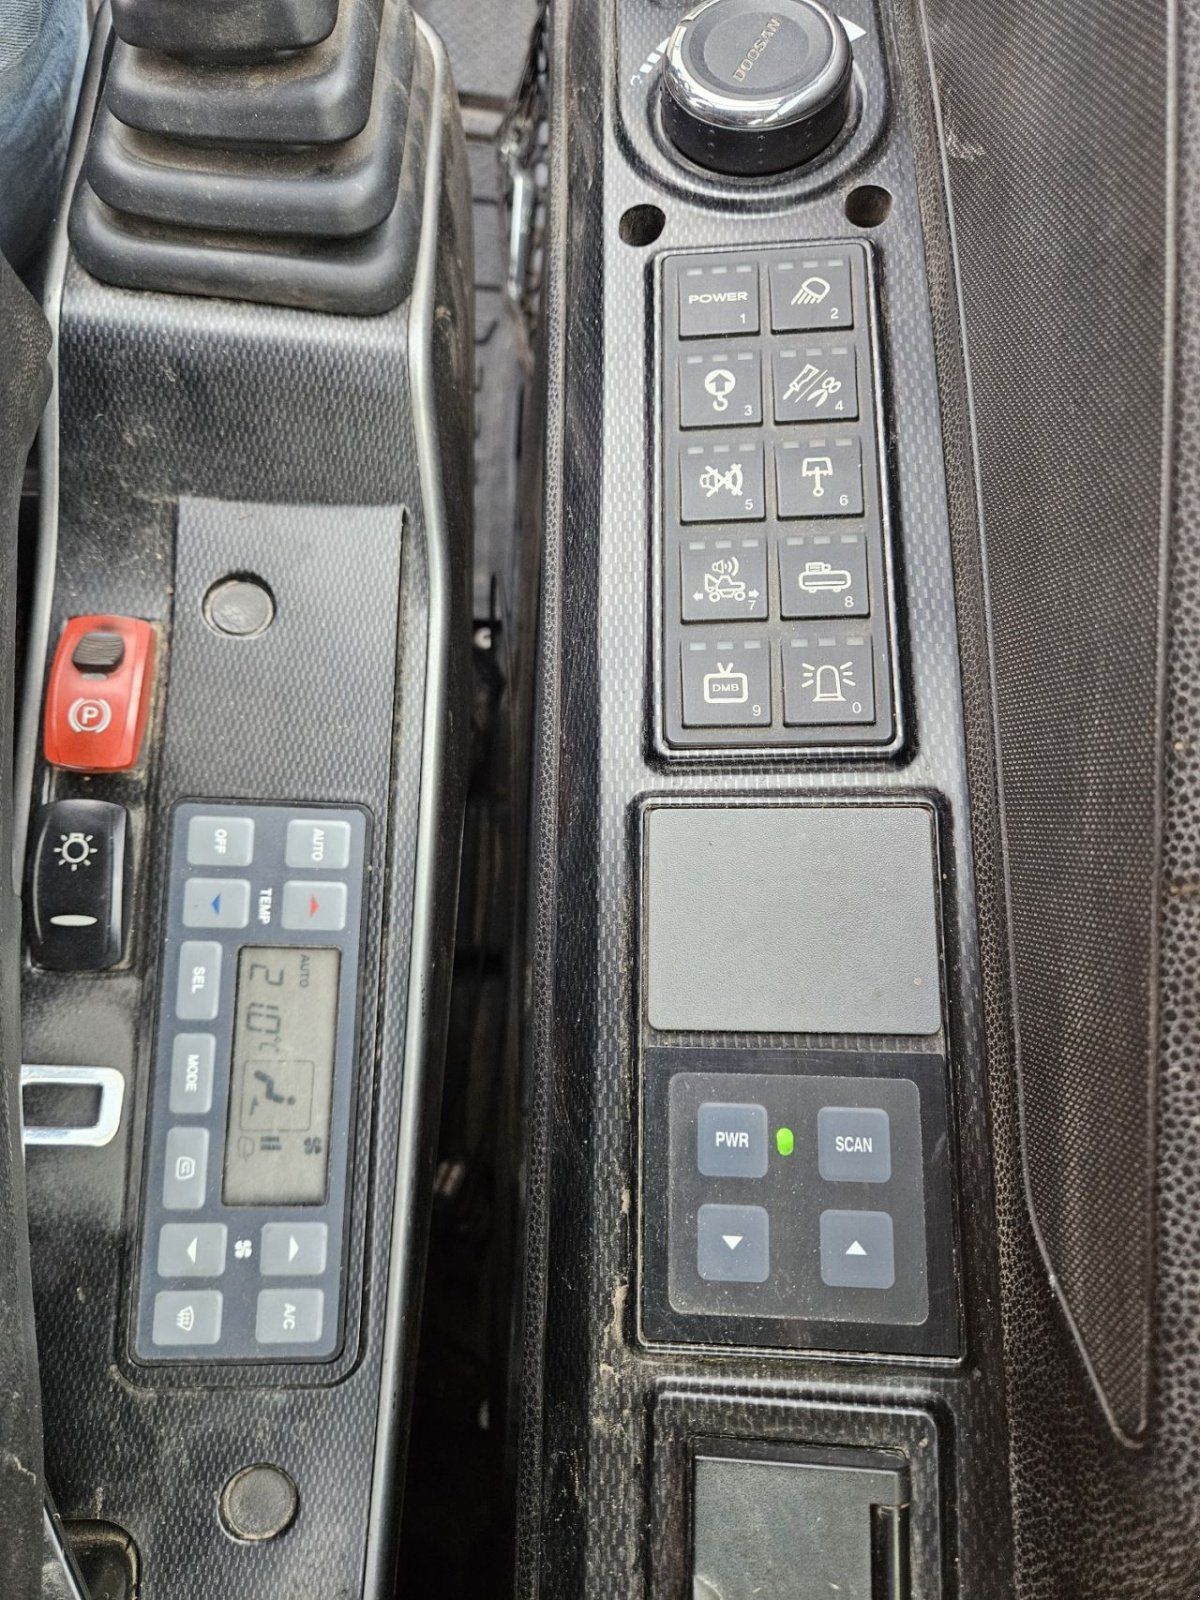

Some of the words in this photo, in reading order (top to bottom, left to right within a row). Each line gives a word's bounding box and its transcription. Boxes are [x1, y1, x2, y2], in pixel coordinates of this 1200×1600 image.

[732, 15, 781, 83] DOOSAN
[688, 291, 748, 304] POWER
[740, 313, 746, 324] 1
[830, 308, 839, 320] 2
[744, 405, 753, 416] 3
[835, 400, 844, 411] 4
[745, 499, 754, 510] 5
[839, 494, 848, 506] 6
[748, 600, 757, 610] 7
[844, 596, 854, 607] 8
[712, 683, 739, 692] DMB
[752, 704, 761, 716] 9
[852, 702, 862, 713] 0
[81, 707, 98, 724] P
[214, 828, 227, 854] OFF
[312, 827, 325, 861] AUTO
[258, 887, 273, 925] TEMP
[299, 954, 312, 988] AUTO
[192, 966, 206, 994] SEL
[185, 1054, 200, 1093] MODE
[715, 1132, 749, 1148] PWR
[835, 1136, 873, 1152] SCAN
[283, 1303, 297, 1330] A/C
